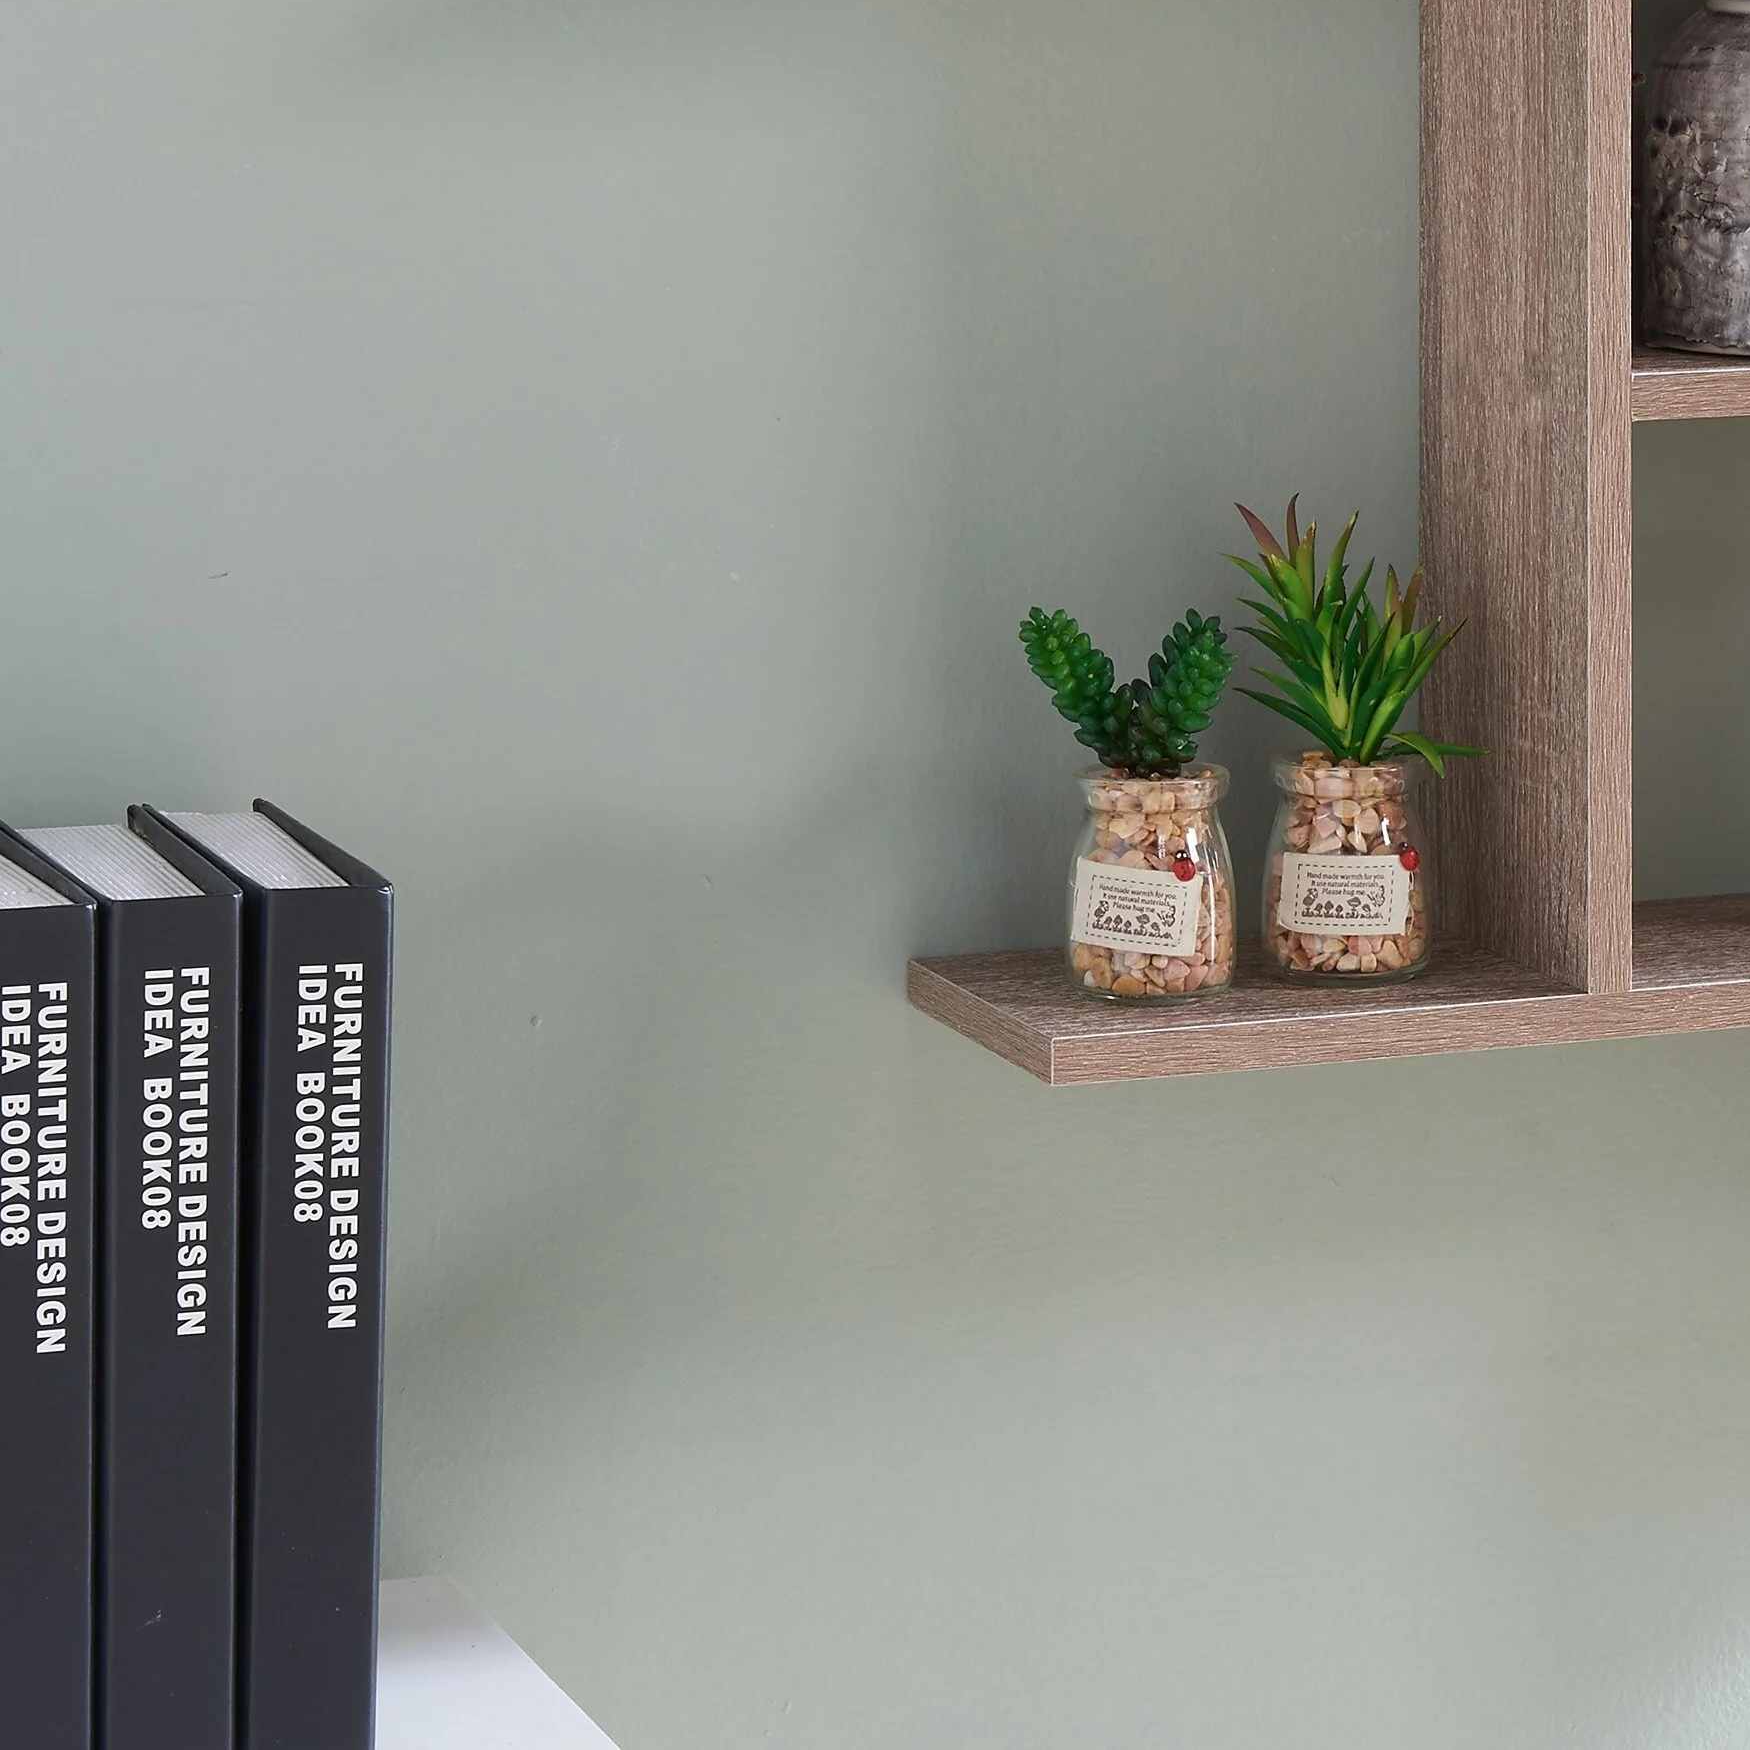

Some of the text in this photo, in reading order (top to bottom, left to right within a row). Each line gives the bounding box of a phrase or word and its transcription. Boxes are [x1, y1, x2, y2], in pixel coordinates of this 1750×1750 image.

[0, 984, 32, 1247] IDEA BOOK08
[36, 982, 68, 1354] FURNITURE DESIGN
[141, 969, 174, 1230] IDEA BOOK08
[176, 966, 210, 1336] FURNITURE DESIGN
[293, 964, 328, 1223] IDEA BOOK08
[327, 963, 364, 1329] FURNITURE DESIGN
